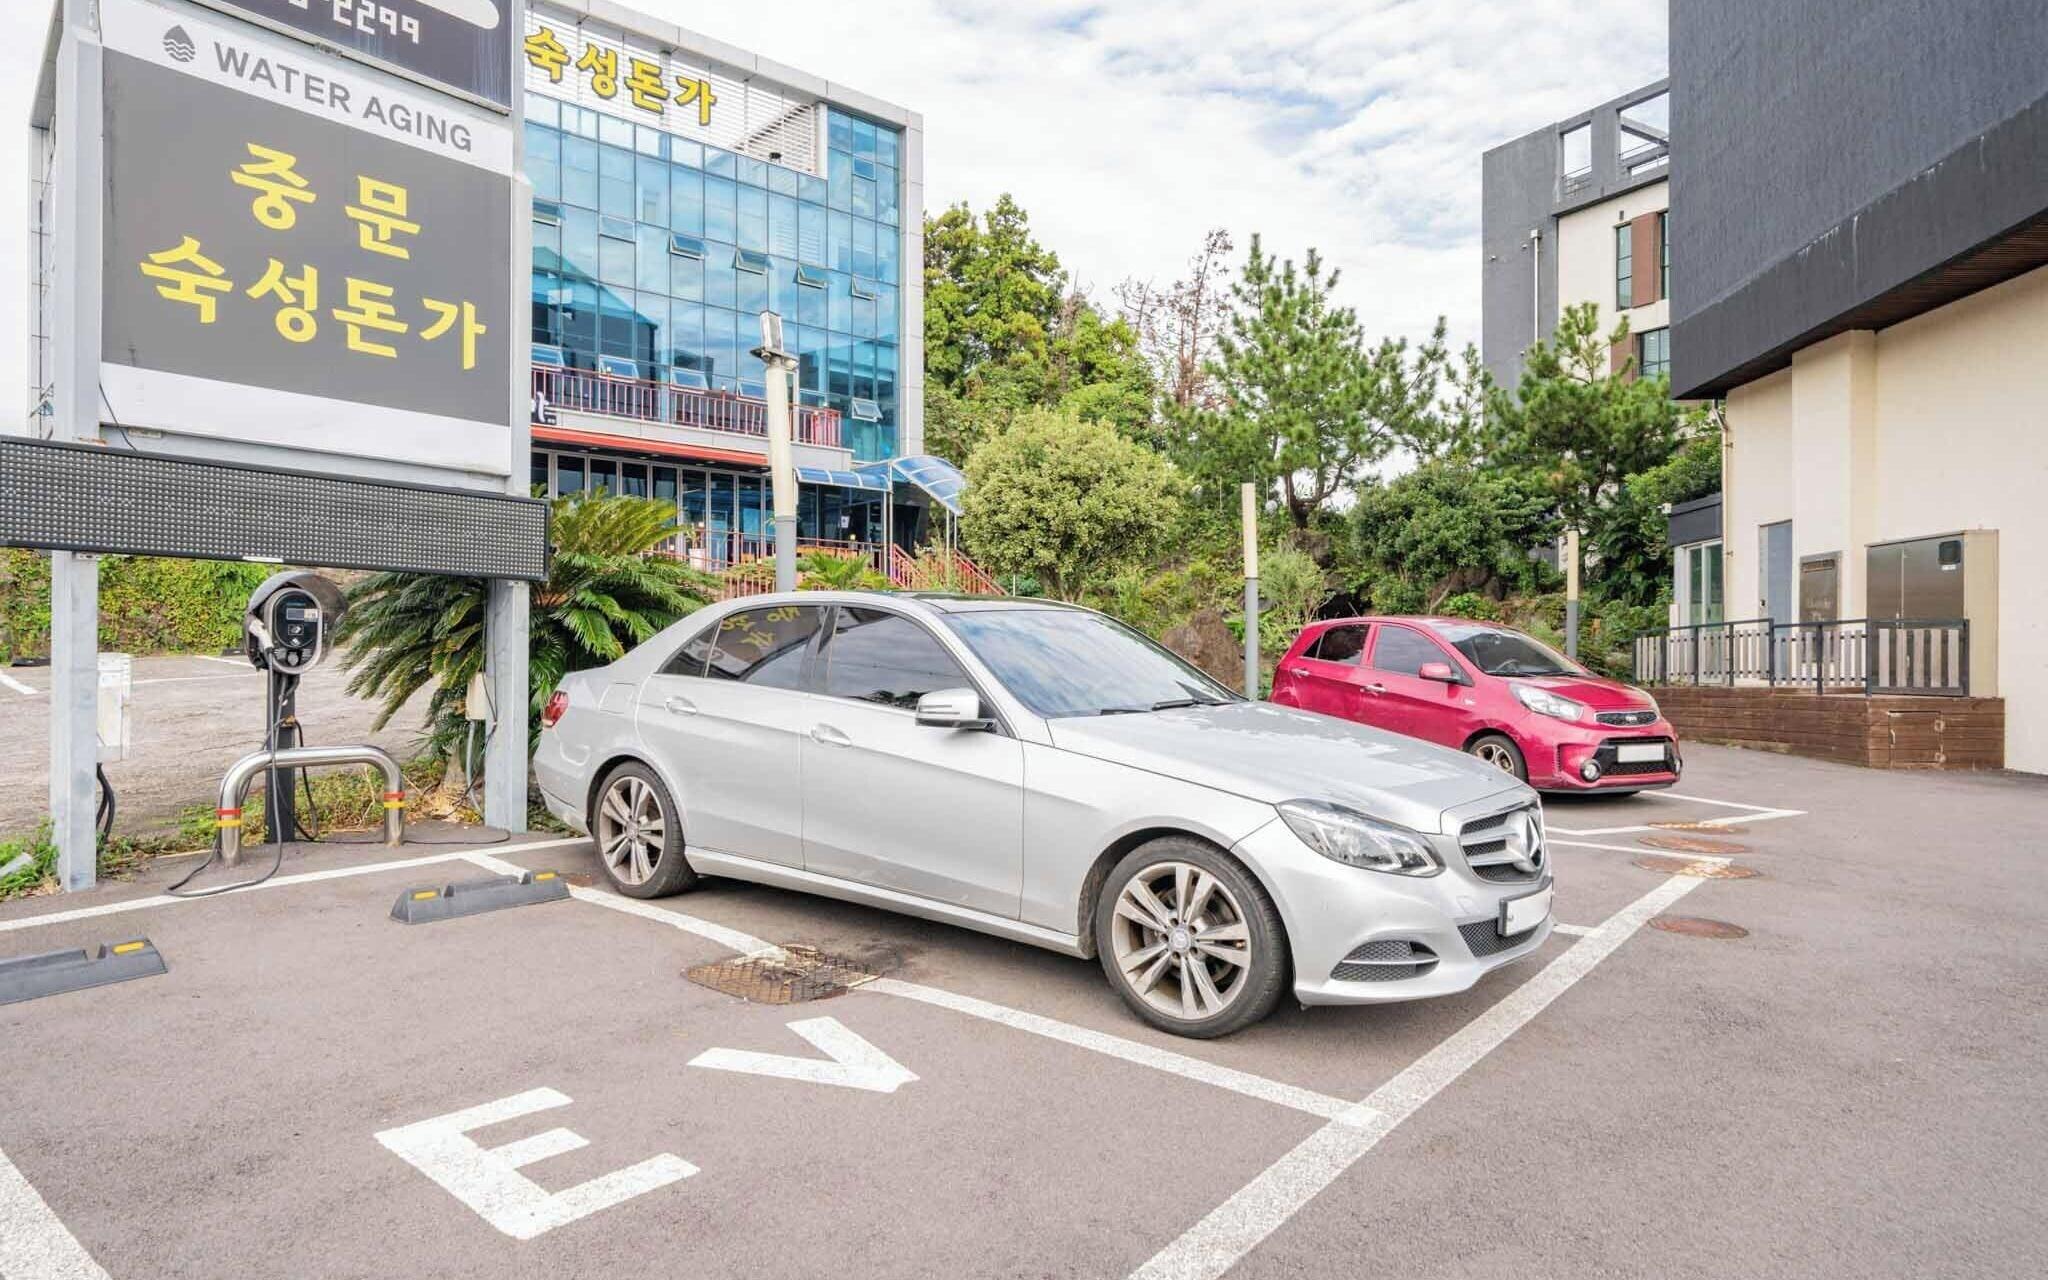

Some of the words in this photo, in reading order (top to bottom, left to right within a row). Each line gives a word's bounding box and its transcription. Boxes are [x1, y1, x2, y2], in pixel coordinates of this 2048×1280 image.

[214, 41, 351, 113] WATER
[363, 96, 472, 153] AGING
[524, 27, 716, 125] 숙성돈가
[139, 235, 487, 370] 숙성돈가
[373, 1016, 921, 1240] EV
